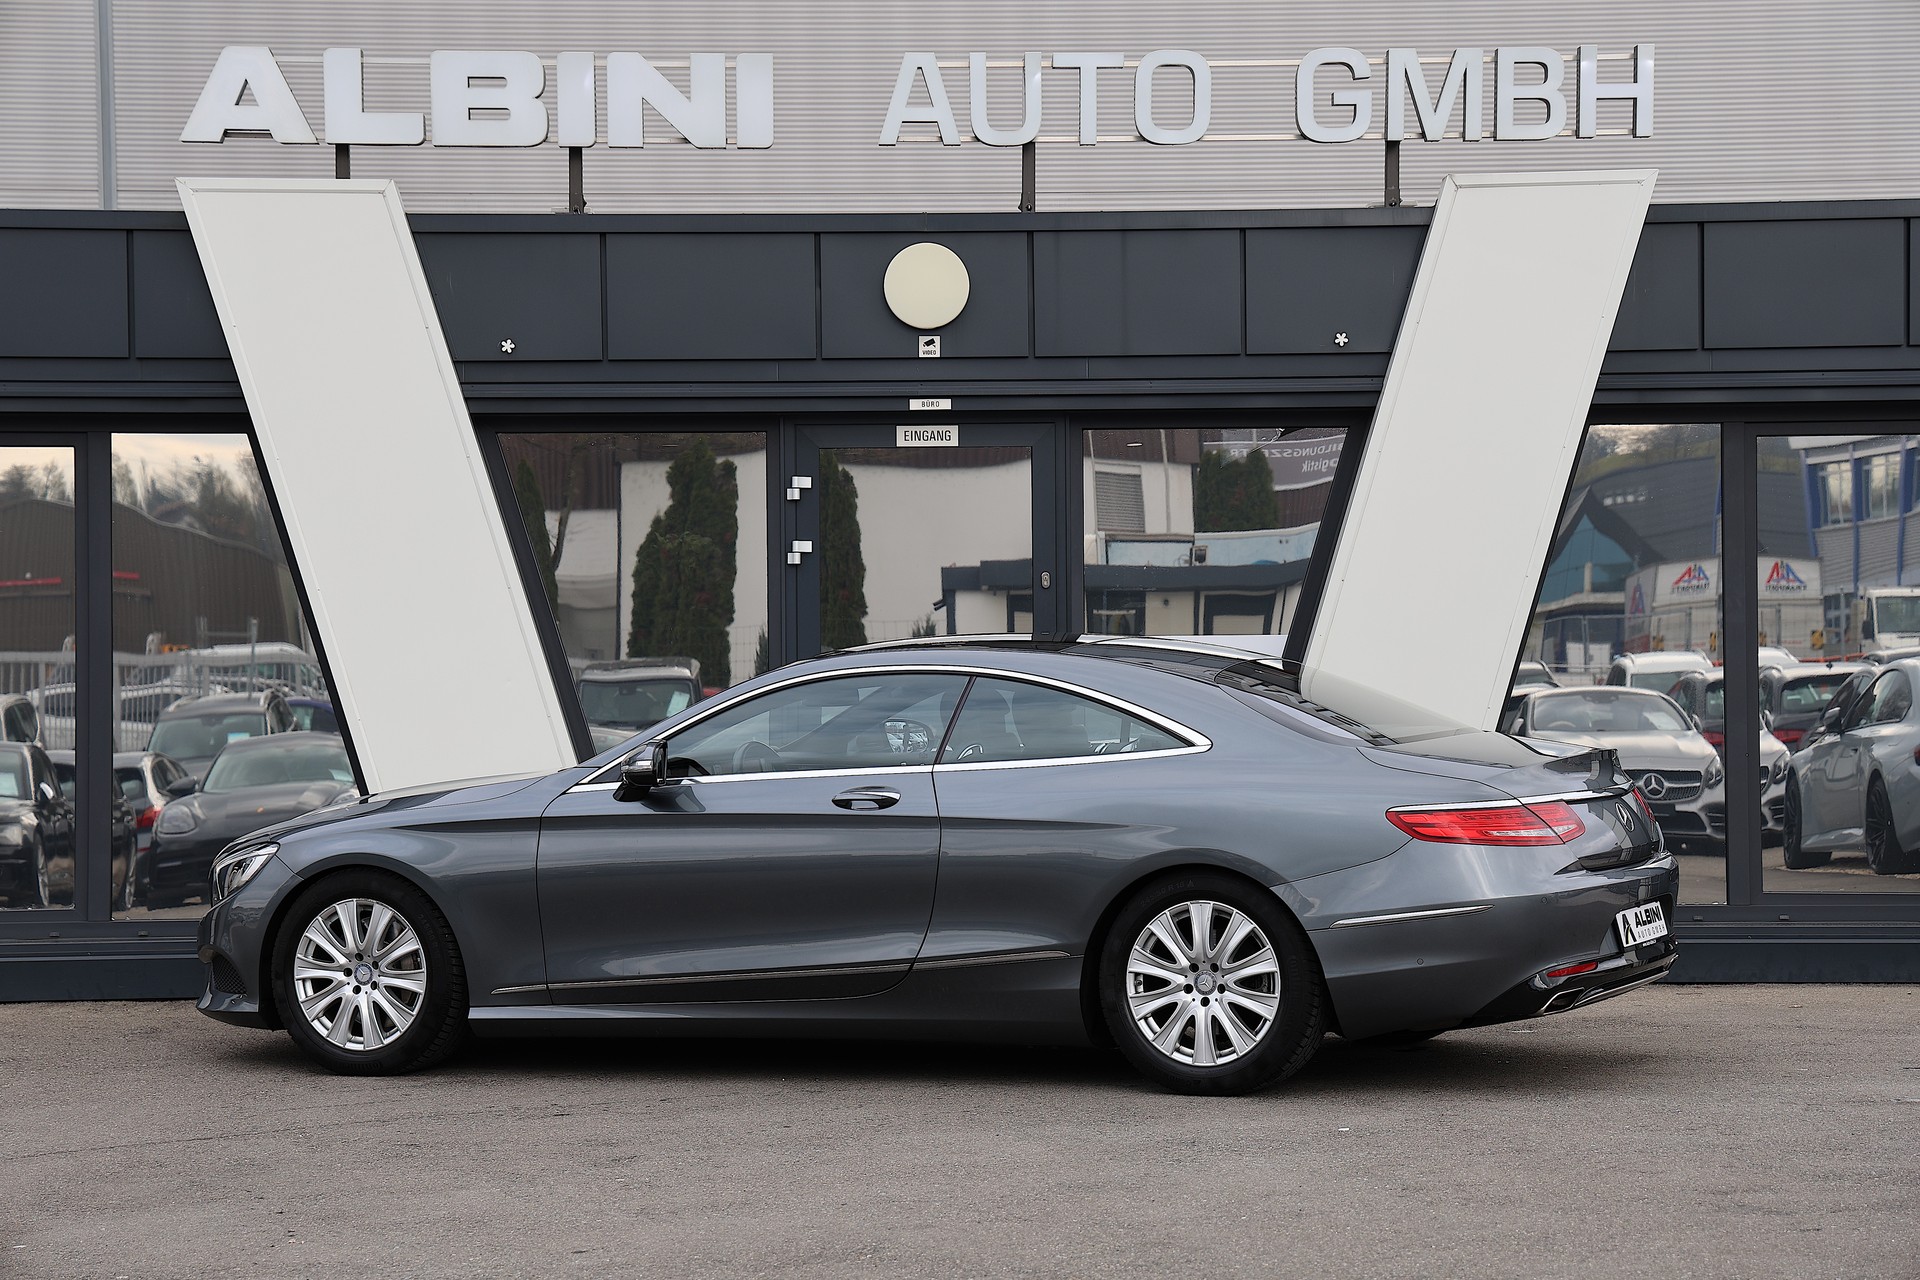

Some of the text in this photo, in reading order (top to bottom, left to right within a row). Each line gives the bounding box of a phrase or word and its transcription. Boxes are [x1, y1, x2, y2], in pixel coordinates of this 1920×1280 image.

[179, 44, 1655, 149] ALBINI AUTO GMBH
[921, 400, 940, 408] BÜRO
[904, 430, 952, 442] EINGANG
[1634, 905, 1662, 928] ALBINI
